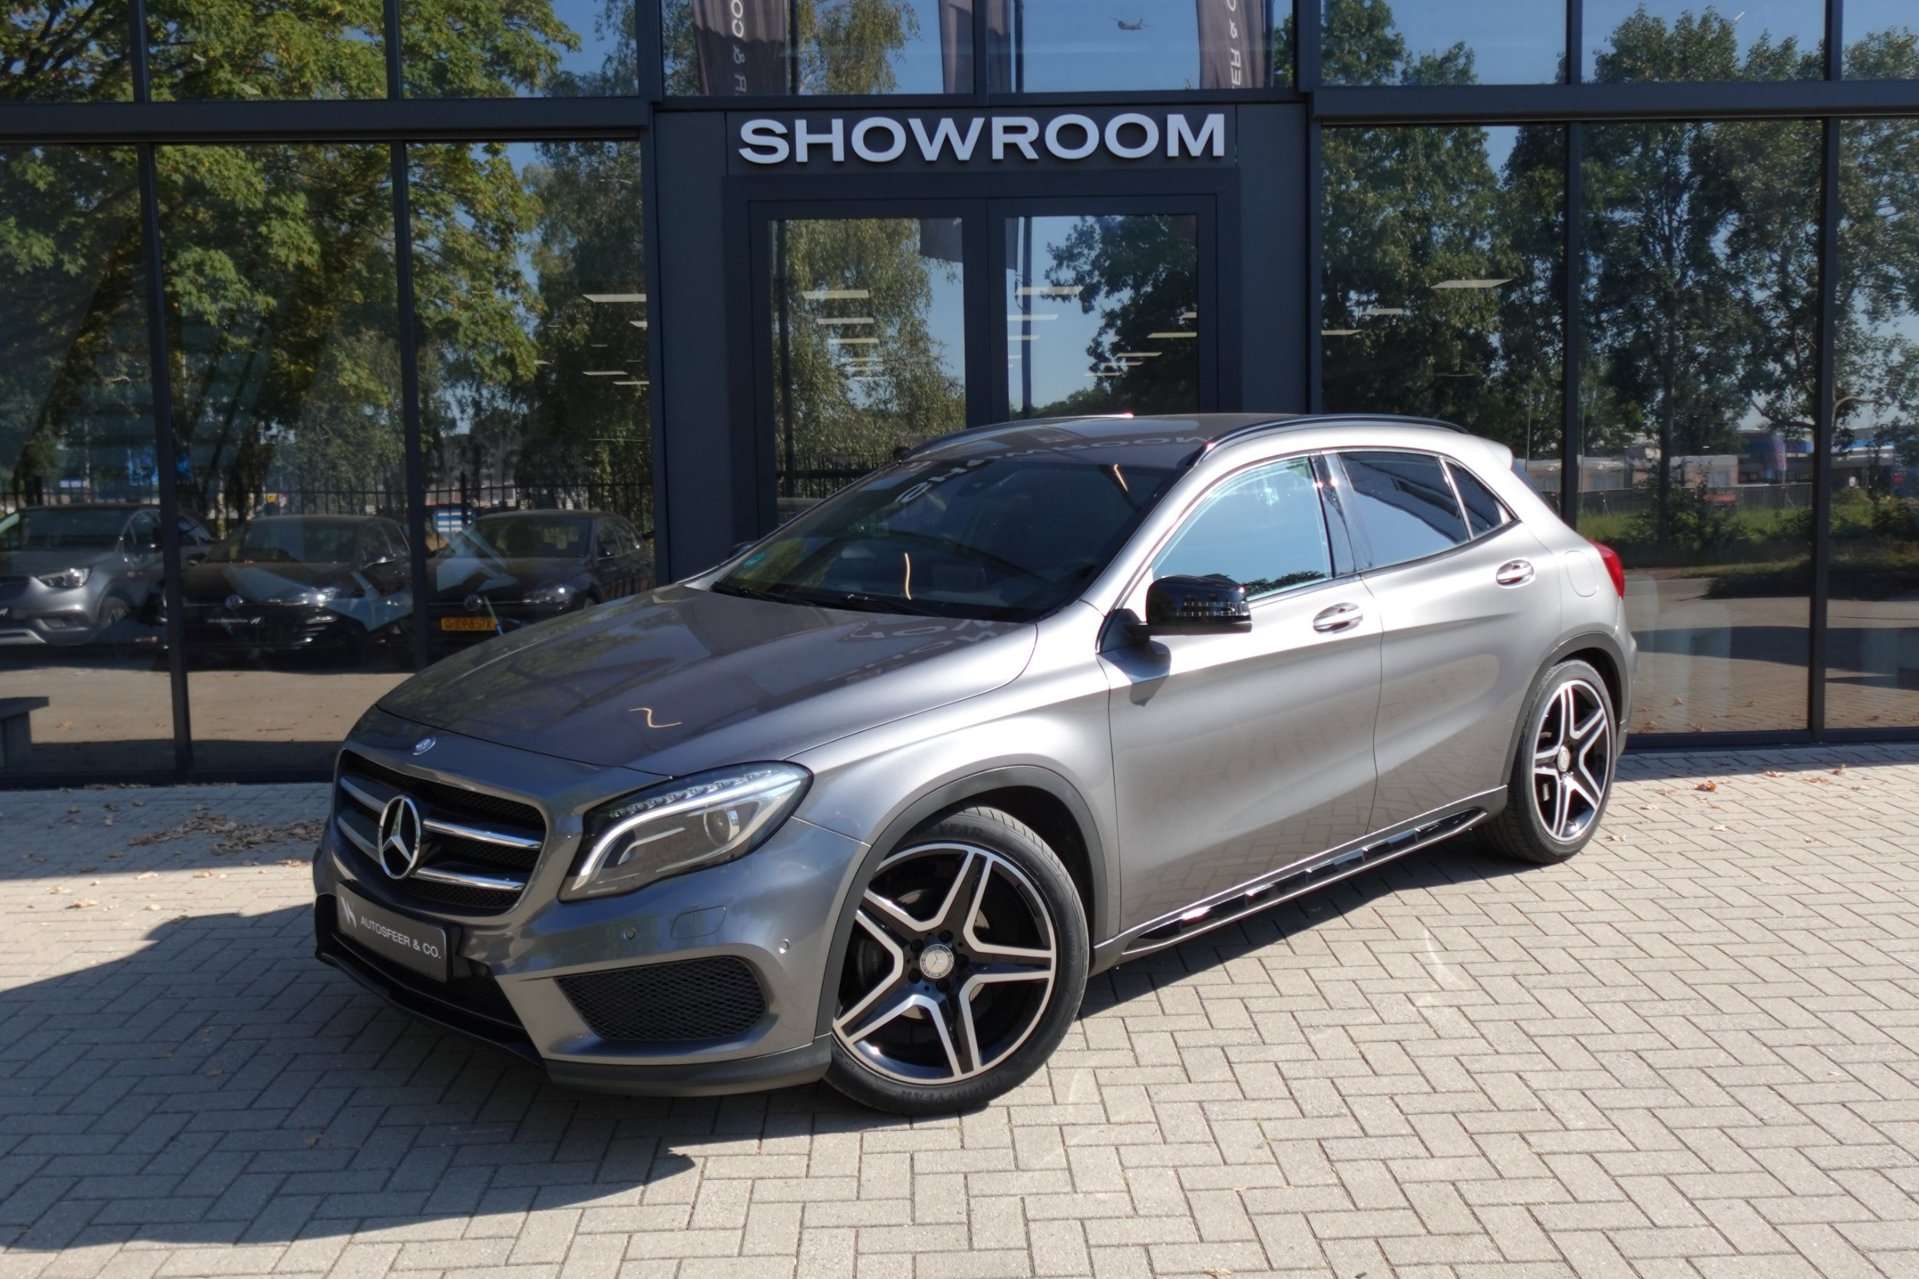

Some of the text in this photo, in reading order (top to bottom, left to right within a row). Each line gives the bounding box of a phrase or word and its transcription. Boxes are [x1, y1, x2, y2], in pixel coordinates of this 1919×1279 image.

[738, 112, 1225, 165] SHOWROOM
[360, 915, 411, 948] AUTOSFEER
[412, 938, 421, 952] &
